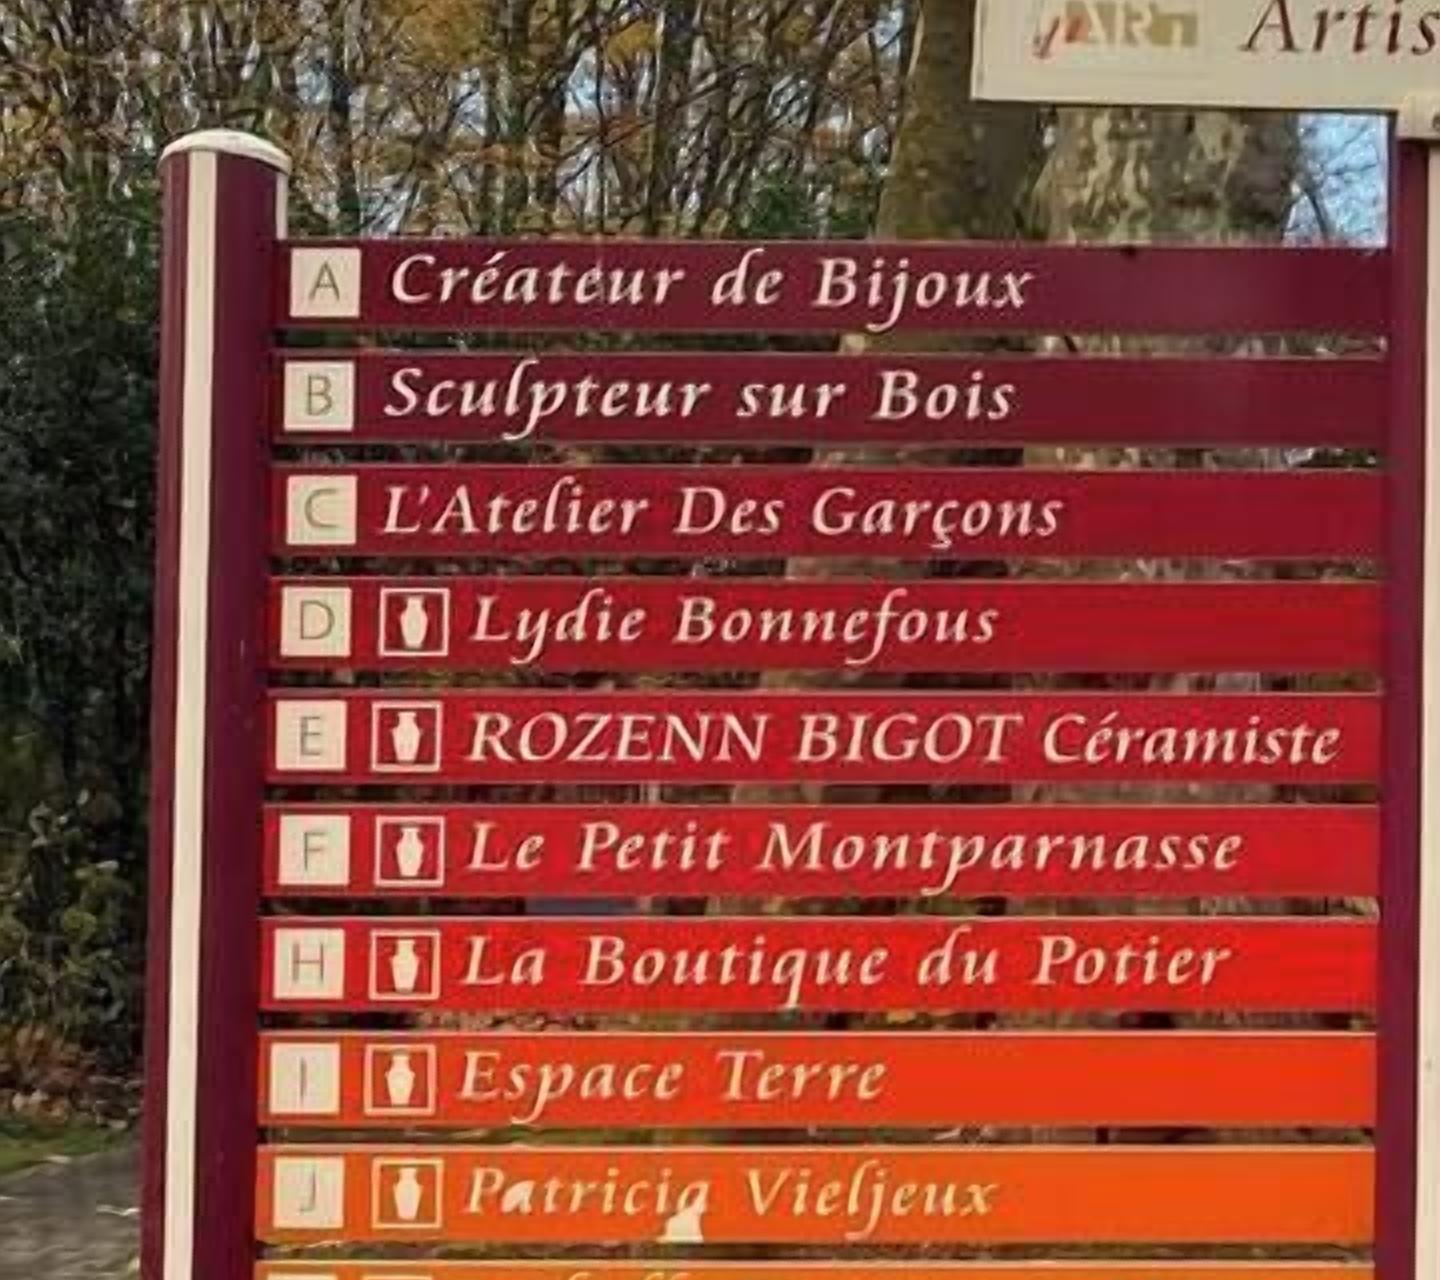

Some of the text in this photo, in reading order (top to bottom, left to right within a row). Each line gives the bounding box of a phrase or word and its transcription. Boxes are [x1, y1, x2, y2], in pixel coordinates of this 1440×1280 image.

[308, 247, 1034, 333] A Créateur de Bijoux
[305, 358, 1017, 440] B Sculpteur sur Bois
[304, 476, 1063, 548] C L'Atelier Des Garçons
[300, 589, 999, 665] D Lydie Bonnefous
[300, 711, 1341, 766] E ROZENN BIGOT Céramiste
[303, 821, 1243, 897] F Le Petit Montparnasse
[292, 926, 1232, 1011] H La Boutique du Potier
[458, 1050, 684, 1126] Espace
[717, 1050, 886, 1101] Terre
[298, 1159, 998, 1240] J Patricia Vieljeux
